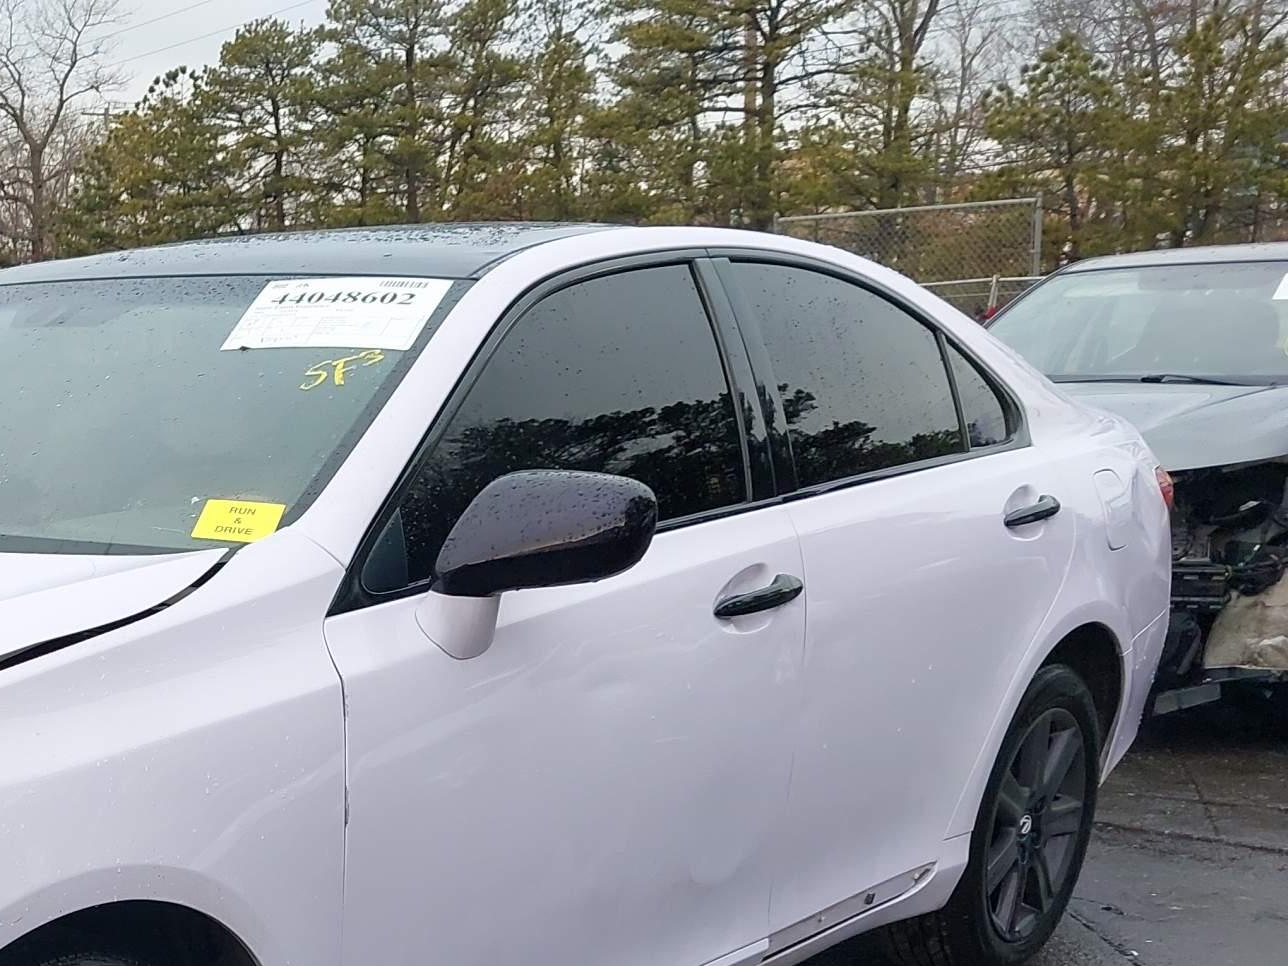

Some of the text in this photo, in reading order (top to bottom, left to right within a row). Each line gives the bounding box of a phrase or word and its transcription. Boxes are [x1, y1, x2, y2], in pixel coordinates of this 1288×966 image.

[271, 291, 416, 305] 44048602
[229, 506, 256, 516] RUN
[214, 525, 255, 536] DRIVE
